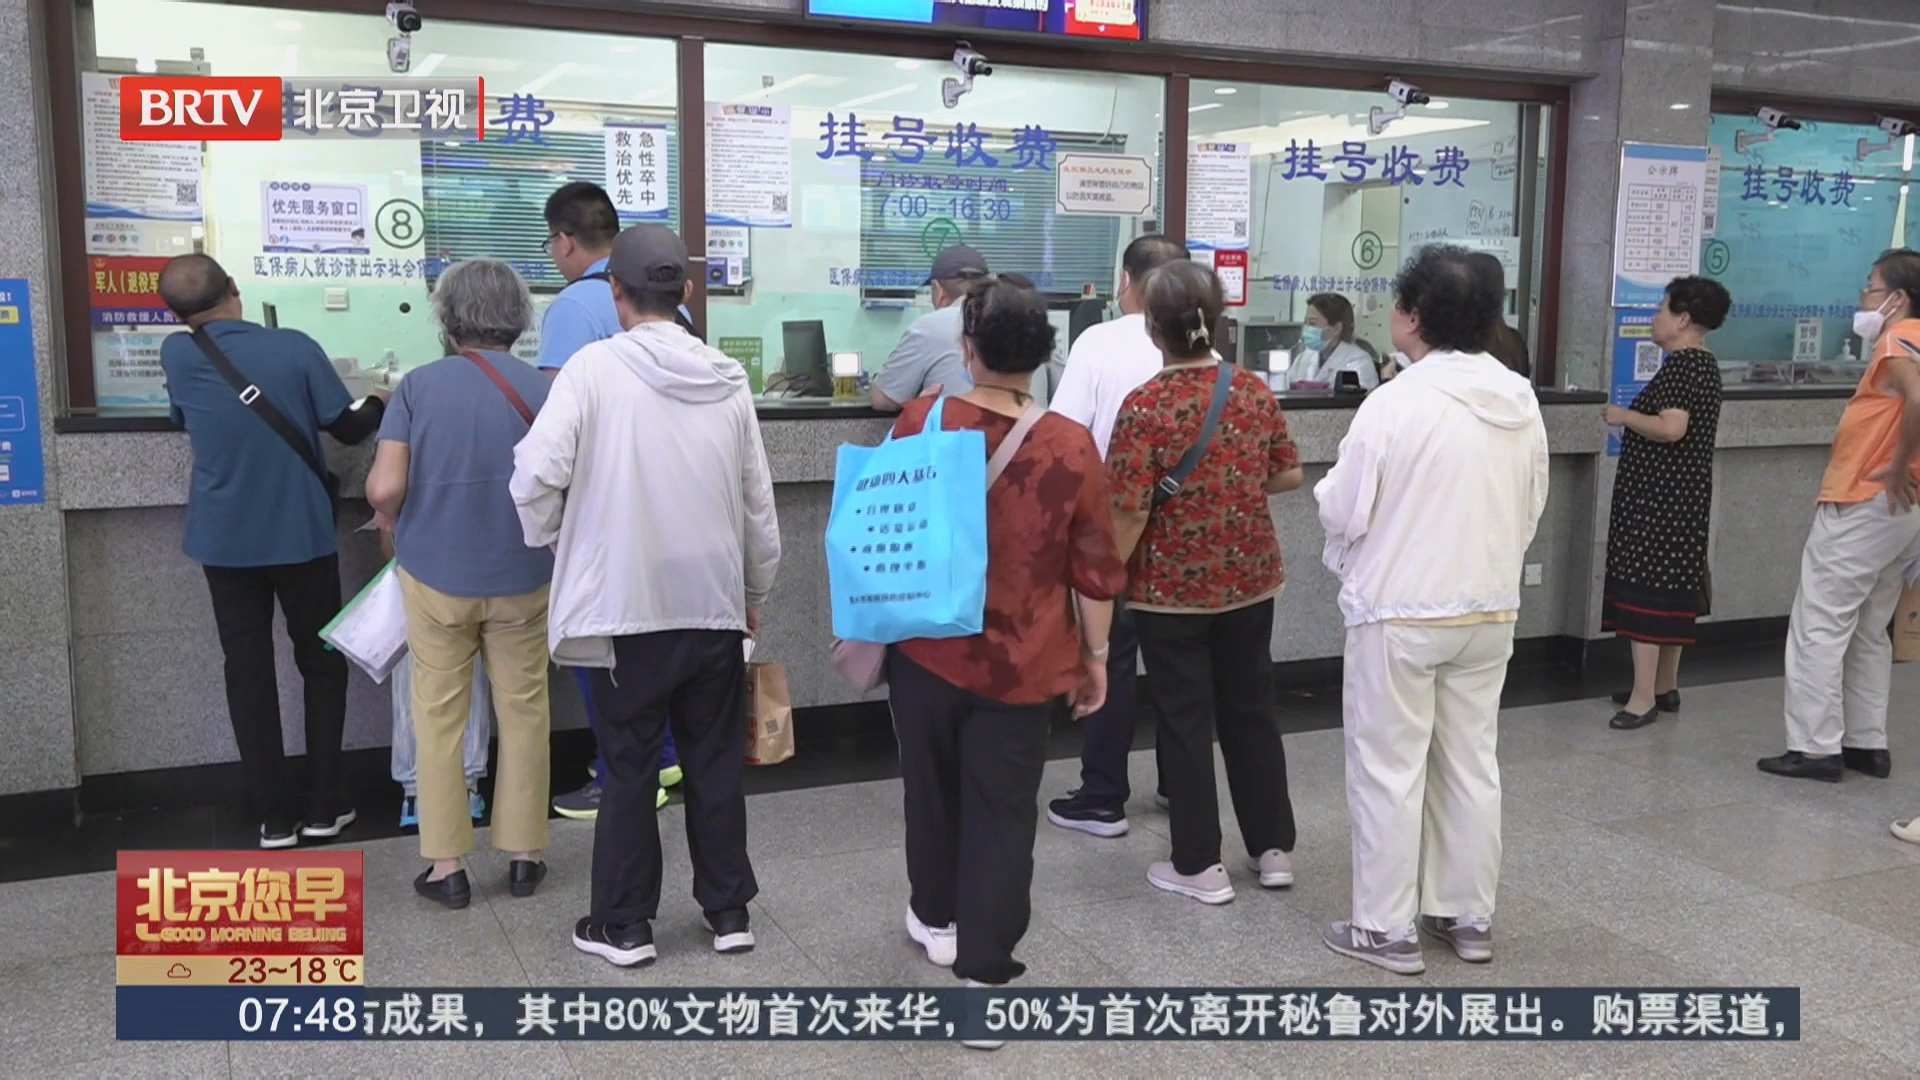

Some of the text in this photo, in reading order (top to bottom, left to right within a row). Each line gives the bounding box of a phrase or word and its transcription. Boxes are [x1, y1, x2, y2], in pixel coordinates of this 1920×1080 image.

[816, 112, 1057, 172] 挂号收费
[1282, 138, 1470, 187] 挂号收费
[615, 130, 633, 205] 救治优先
[638, 131, 656, 206] 急性卒中
[1647, 164, 1679, 177] 公示牌
[1741, 164, 1857, 207] 挂号收费
[272, 198, 359, 216] 优先服务窗口
